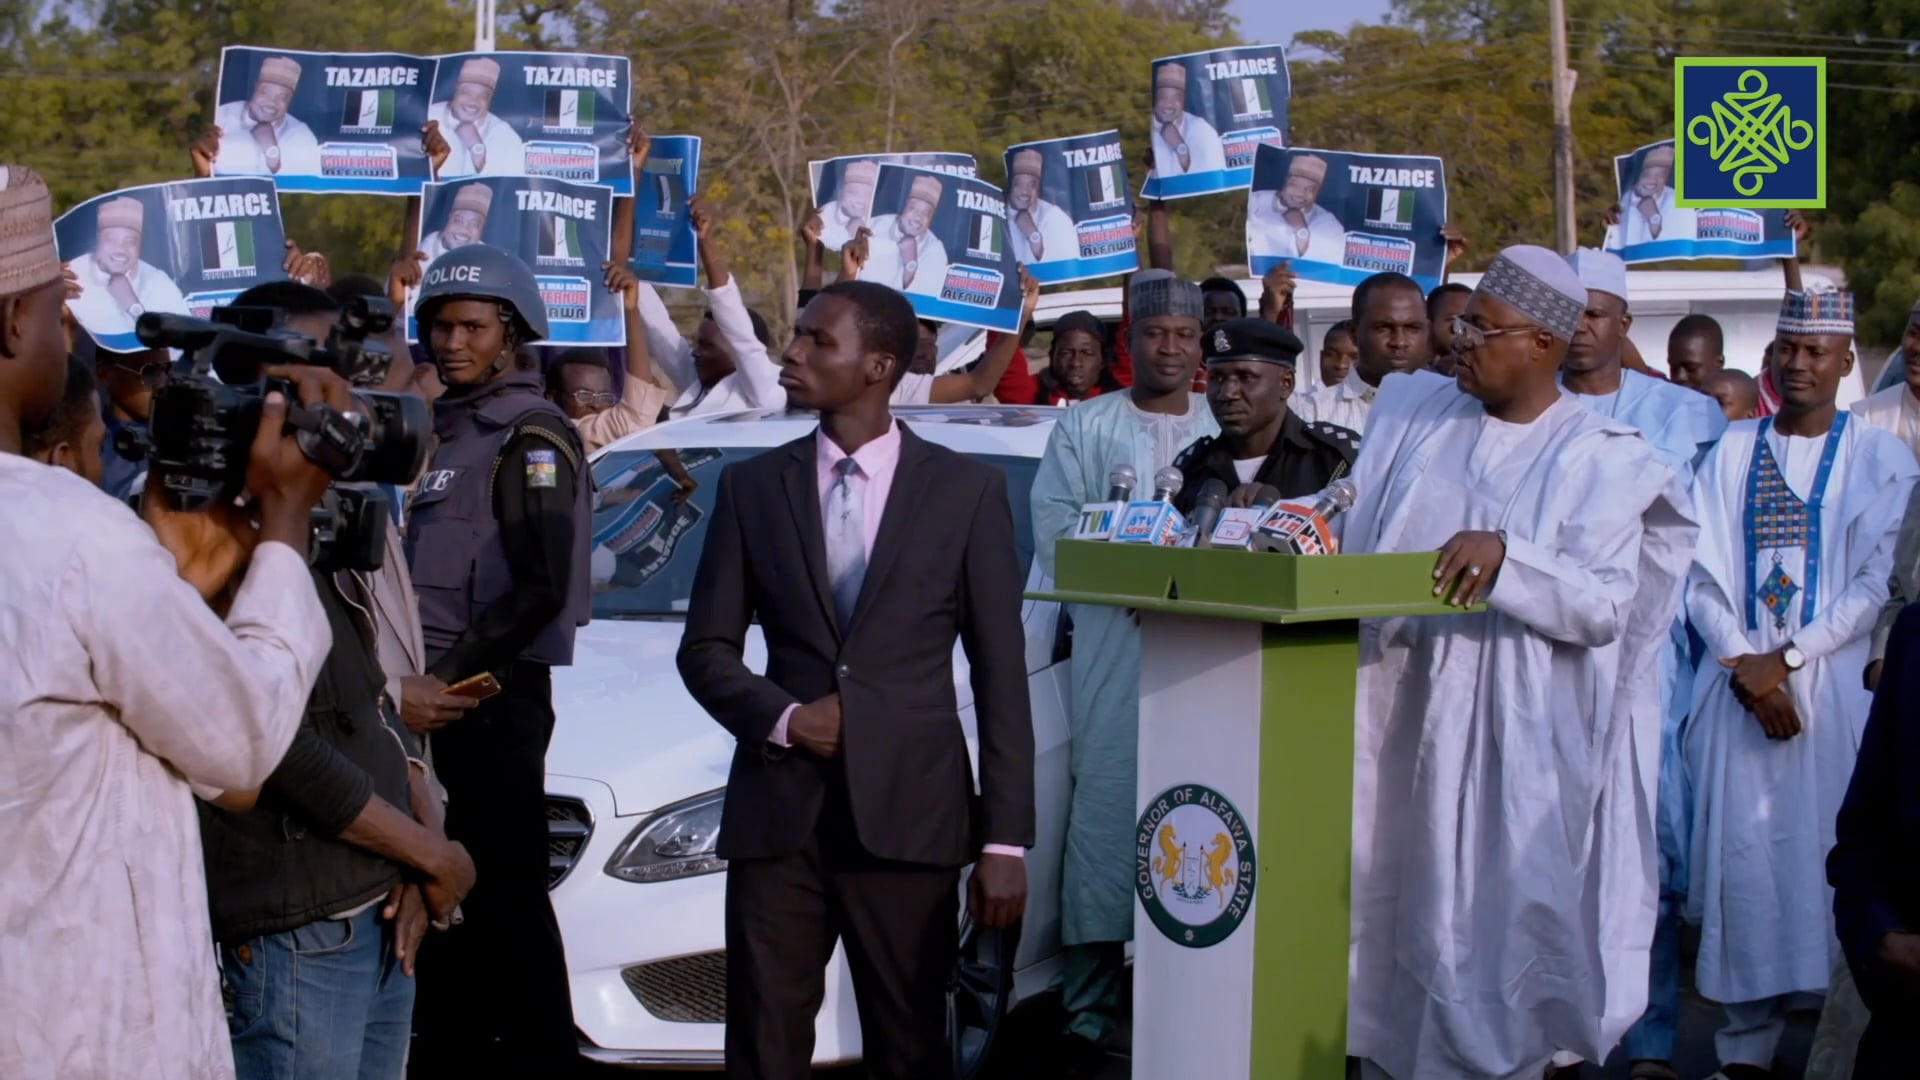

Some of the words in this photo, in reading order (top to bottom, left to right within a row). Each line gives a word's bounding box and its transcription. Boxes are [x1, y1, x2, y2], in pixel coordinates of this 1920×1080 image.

[324, 66, 419, 87] TAZARCE
[523, 66, 617, 88] TAZARCE
[1205, 57, 1277, 80] TAZARCE
[1229, 156, 1254, 167] ALF
[1348, 165, 1434, 188] TAZARCE
[170, 192, 272, 222] TAZARCE
[516, 190, 597, 220] TAZARCE
[957, 189, 1006, 220] TAZARCE
[1083, 240, 1134, 256] ALFAWA
[1346, 257, 1406, 272] ALFAWA
[946, 277, 1000, 292] GOVERNOR
[943, 289, 993, 305] ALFAWA
[549, 308, 584, 318] AWA
[1080, 510, 1114, 534] TVN
[1137, 799, 1170, 899] GOVERNOR
[1174, 788, 1193, 804] OF
[1200, 791, 1247, 852] ALFAWA
[1229, 861, 1251, 919] STATE
